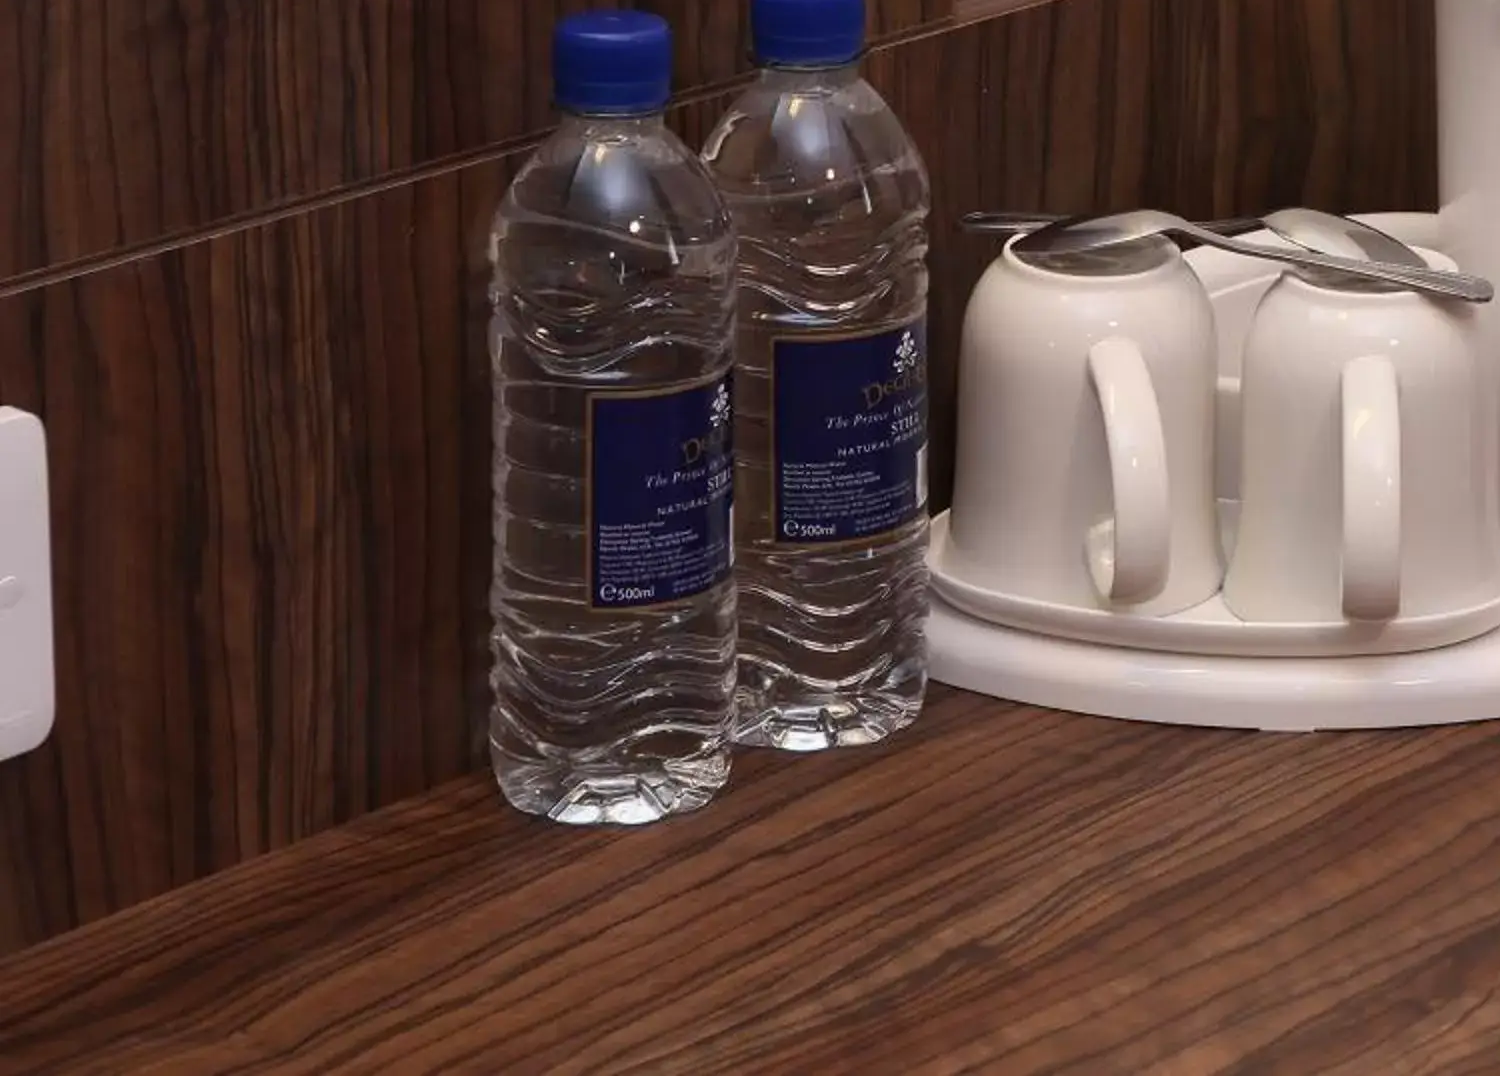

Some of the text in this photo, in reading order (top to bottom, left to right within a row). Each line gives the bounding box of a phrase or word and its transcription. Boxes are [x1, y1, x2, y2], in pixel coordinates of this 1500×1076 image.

[836, 438, 890, 457] NATURAL
[800, 524, 836, 536] 500ml
[617, 585, 655, 601] 500ml
